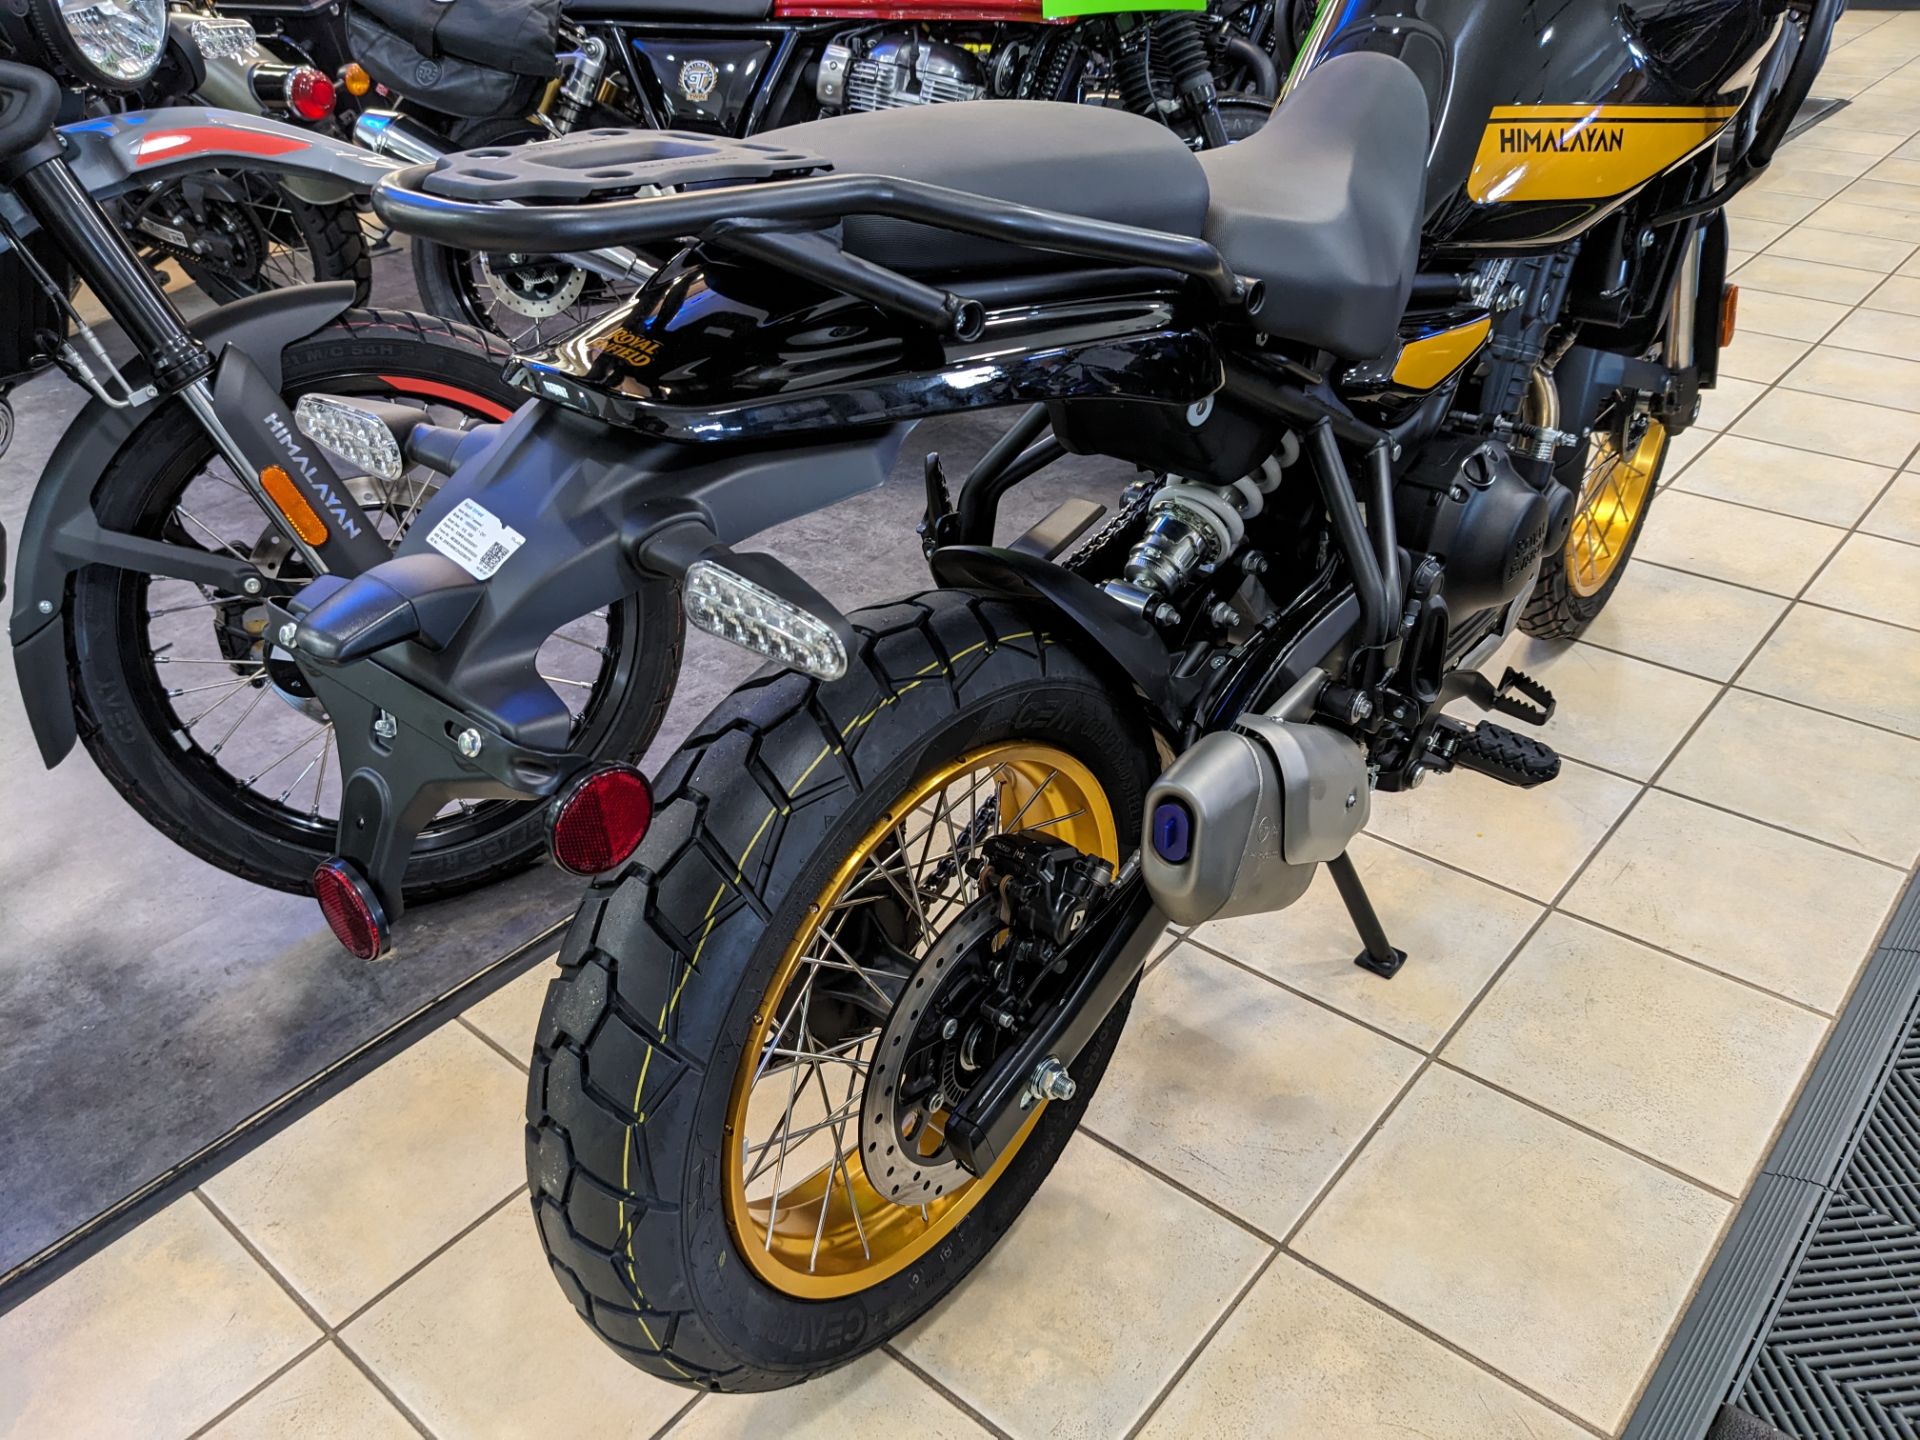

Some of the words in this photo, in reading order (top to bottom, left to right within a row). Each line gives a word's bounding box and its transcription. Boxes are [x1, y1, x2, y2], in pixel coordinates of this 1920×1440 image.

[687, 70, 708, 88] GT
[1499, 127, 1624, 153] HIMALAYAN
[612, 328, 661, 355] ROYAL
[263, 411, 362, 540] HIMALAYAN
[792, 1307, 867, 1352] CEAT
